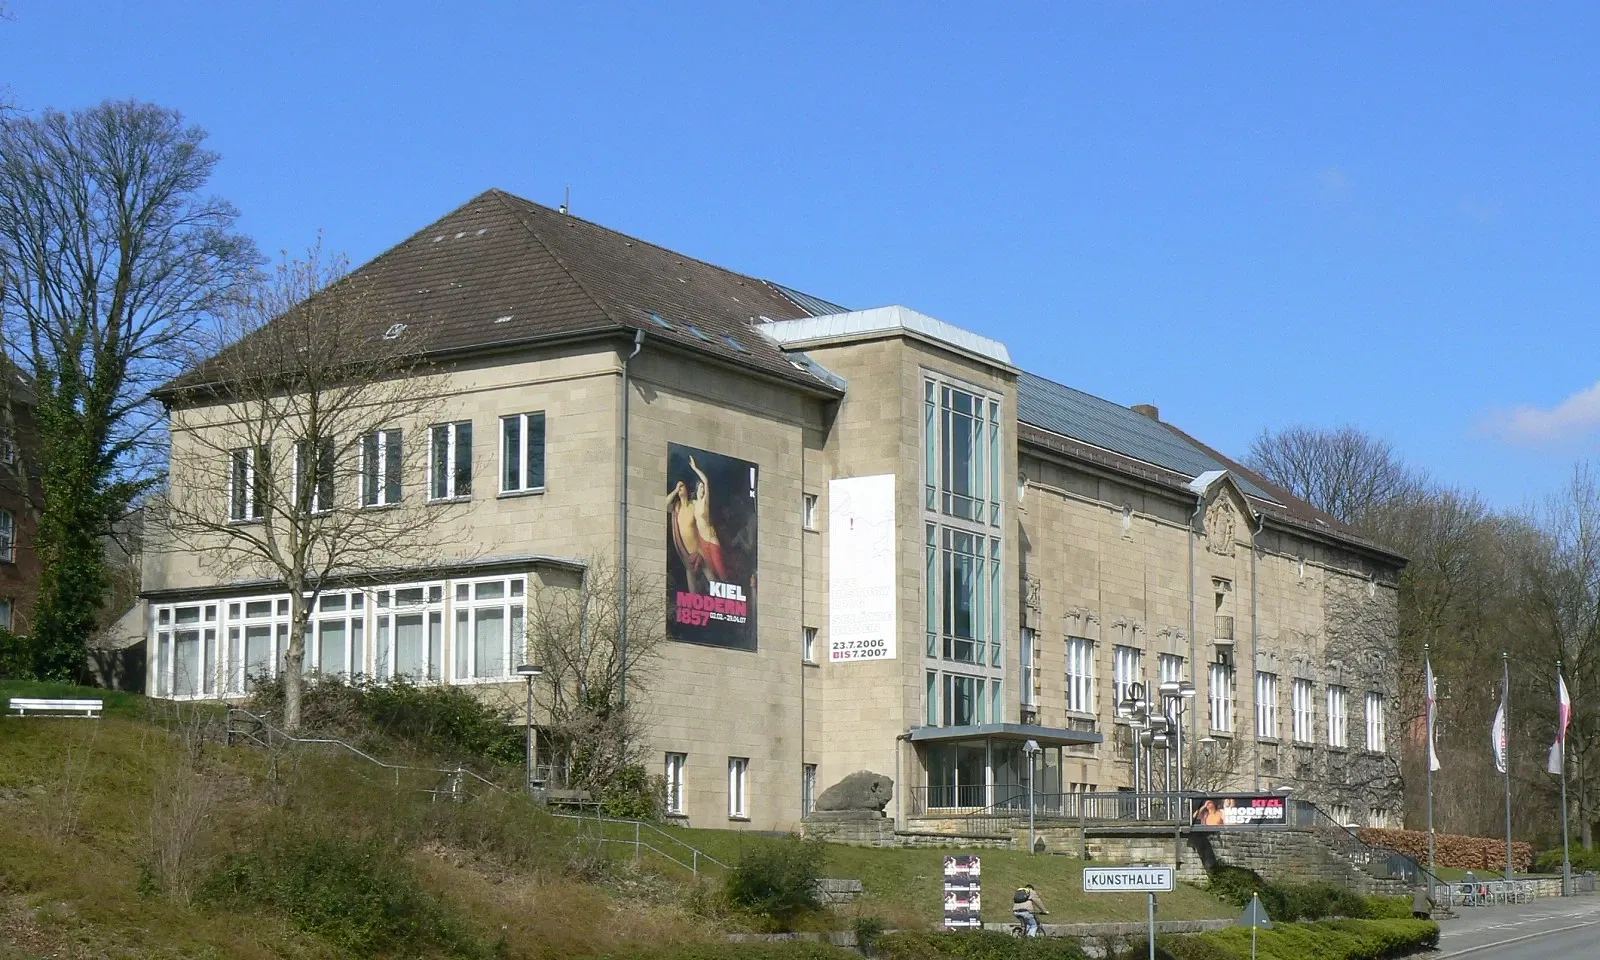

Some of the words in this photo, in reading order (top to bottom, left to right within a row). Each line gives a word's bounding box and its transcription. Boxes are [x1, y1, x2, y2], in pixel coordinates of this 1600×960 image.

[709, 580, 746, 602] KIEL
[676, 591, 747, 617] MODERN
[676, 607, 710, 626] 1857
[832, 638, 885, 650] 23.7.2006
[832, 650, 851, 659] BIS
[852, 648, 888, 658] 7.2007
[1223, 806, 1283, 817] MODERN
